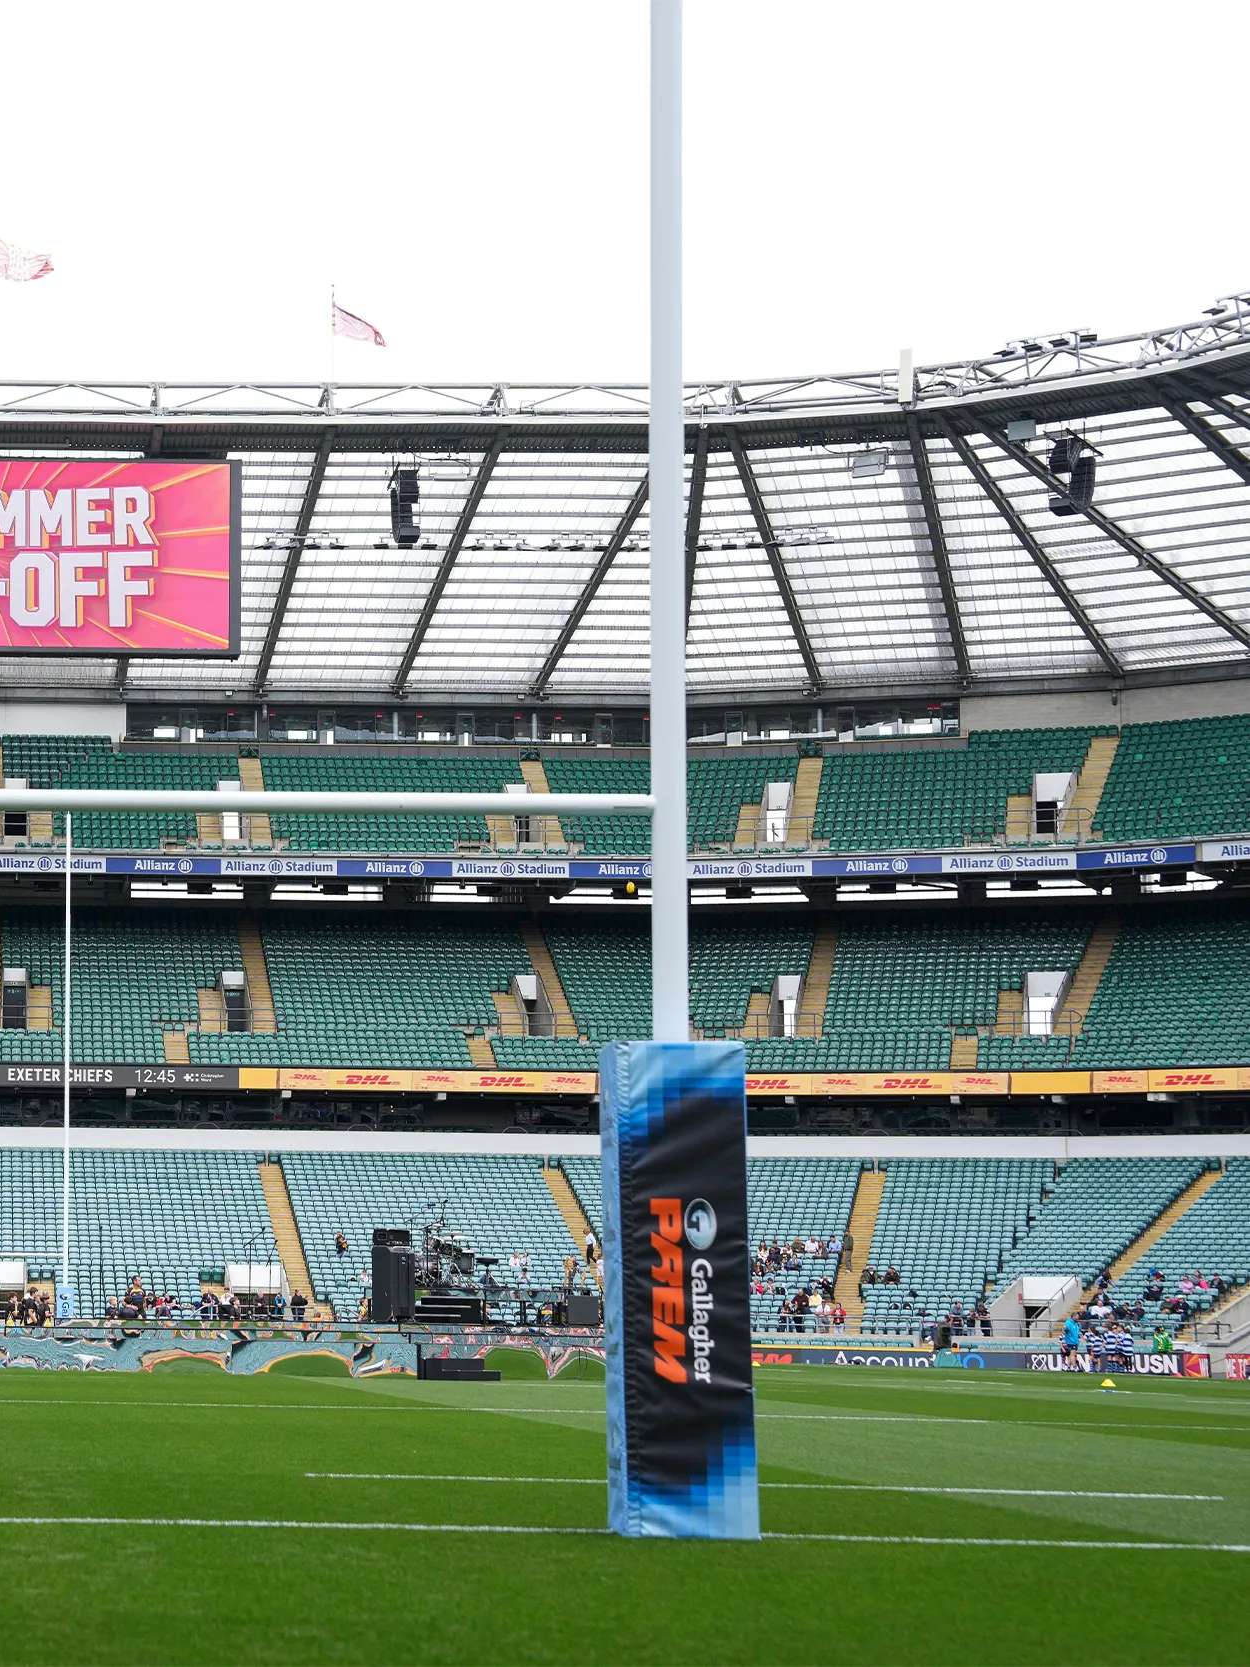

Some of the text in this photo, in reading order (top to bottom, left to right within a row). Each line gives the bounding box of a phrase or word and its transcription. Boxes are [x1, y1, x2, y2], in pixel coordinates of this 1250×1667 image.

[950, 854, 1069, 870] Allianz Stadium
[1104, 850, 1148, 865] Allianz
[134, 858, 175, 871] Allianz
[225, 860, 333, 873] Allianz Stadium
[365, 861, 407, 874] Allianz
[457, 862, 565, 875] Allianz Stadium
[598, 863, 639, 876] Allianz
[693, 861, 805, 876] Allianz Stadium
[846, 859, 890, 873] Allianz
[7, 1068, 60, 1081] EXETER
[68, 1069, 113, 1082] CHIEFS
[134, 1069, 176, 1083] 12:45
[293, 1073, 317, 1081] DHL
[345, 1075, 391, 1086] DHL
[479, 1076, 526, 1087] DHL
[965, 1077, 992, 1085] DHL
[1164, 1074, 1215, 1086] DHL
[745, 1079, 791, 1089] DHL
[883, 1078, 933, 1089] DHL
[650, 1198, 688, 1383] PREM
[688, 1258, 715, 1384] Gallagher
[1134, 1354, 1178, 1374] USN
